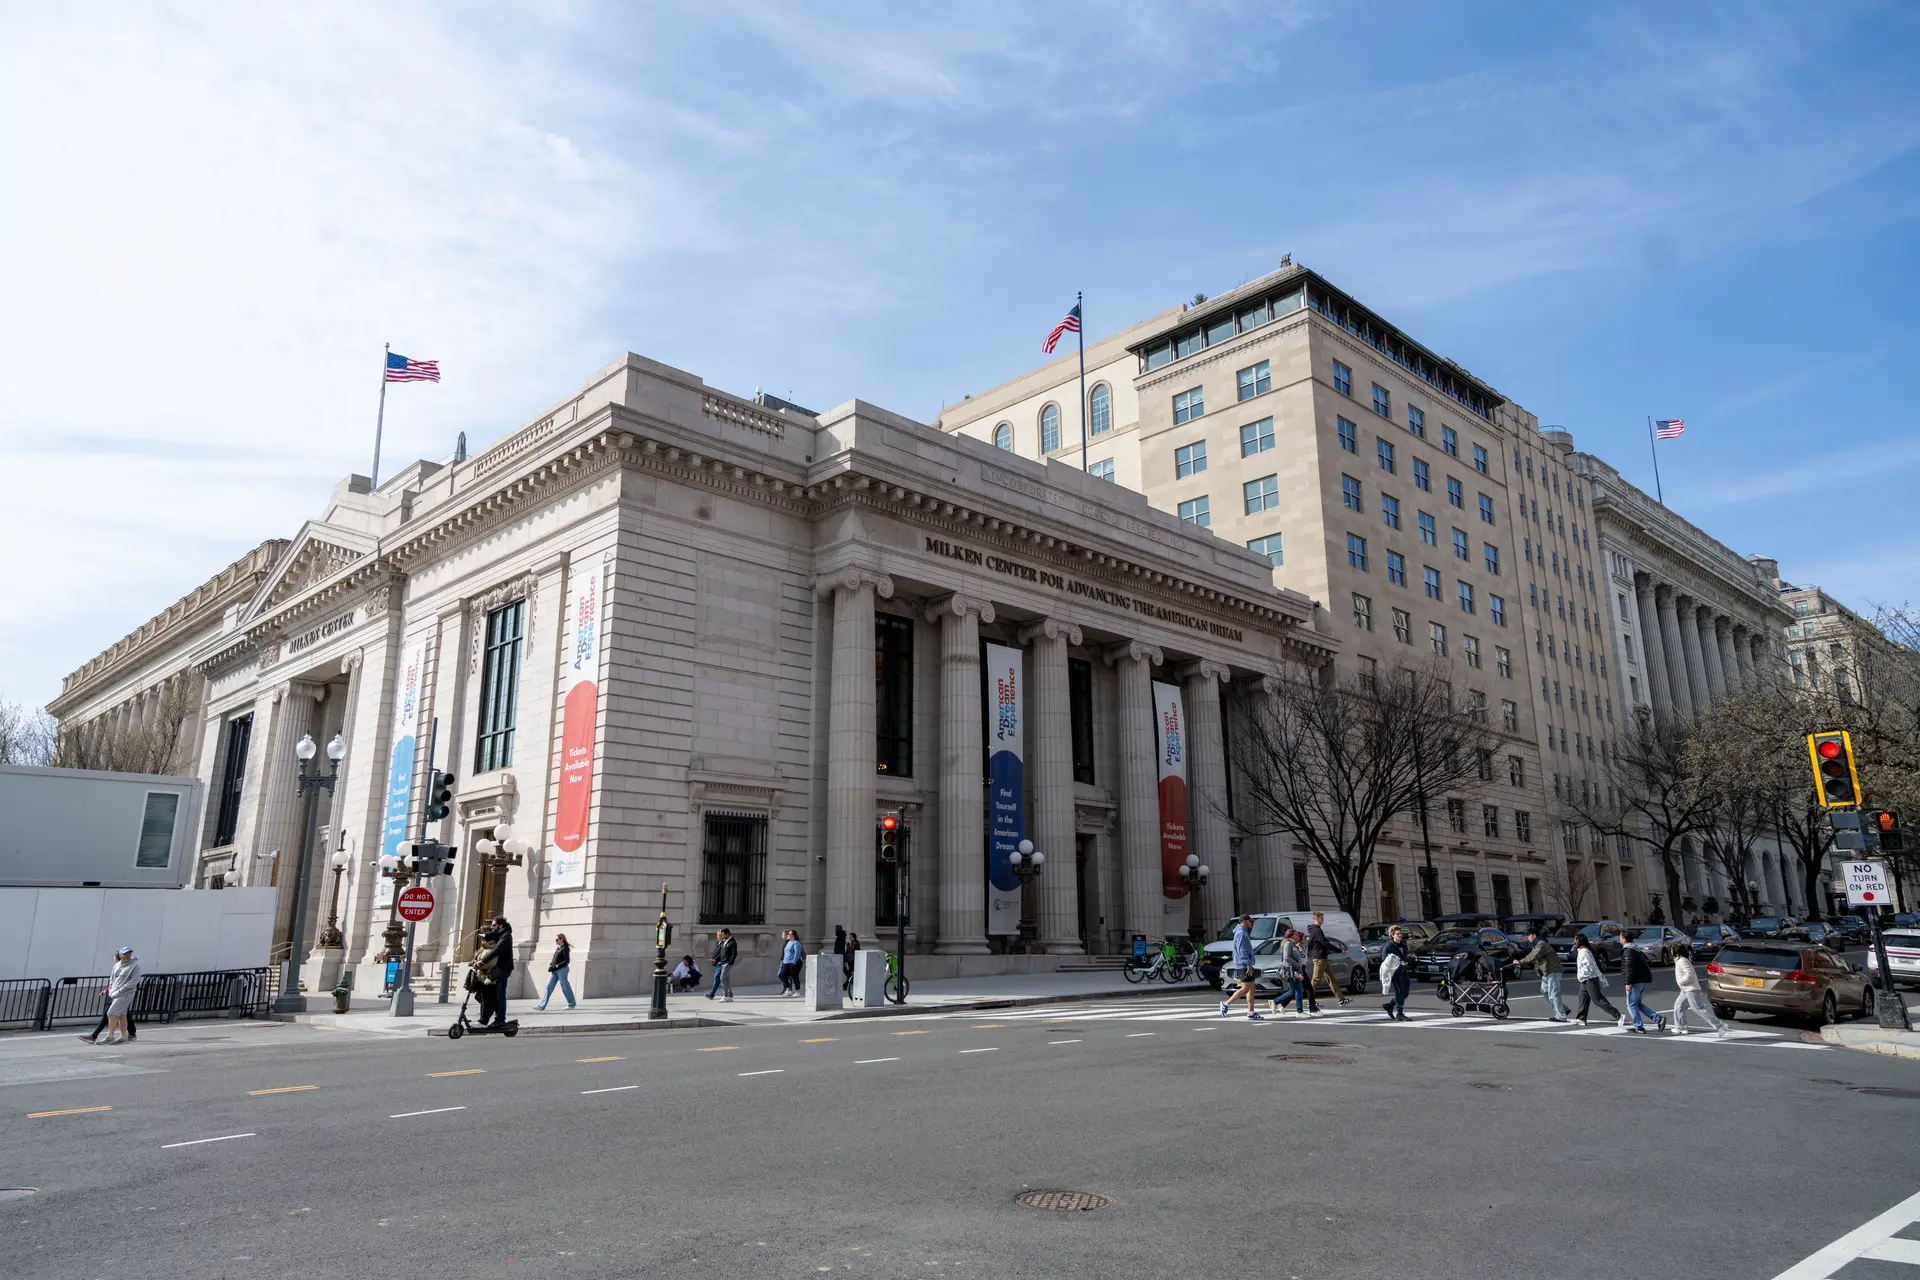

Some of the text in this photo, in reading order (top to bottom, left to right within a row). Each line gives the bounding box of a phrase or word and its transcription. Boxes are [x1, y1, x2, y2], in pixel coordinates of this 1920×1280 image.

[926, 536, 1243, 643] MILKEN CENTER FOR ADVANCING THE AMERICAN DREAM
[585, 575, 596, 660] Experience
[581, 599, 590, 653] Dream
[574, 596, 585, 670] American
[1002, 684, 1010, 728] Dream
[1008, 667, 1017, 737] Experience
[997, 678, 1005, 741] American
[1171, 702, 1182, 763] Experience
[1164, 711, 1173, 766] American
[569, 746, 587, 757] Tickets
[564, 758, 590, 771] Available
[569, 774, 583, 784] Now
[1000, 788, 1012, 797] Find
[995, 801, 1017, 811] Yourself
[997, 814, 1013, 824] in the
[1166, 822, 1184, 831] Tickets
[993, 827, 1019, 838] American
[995, 841, 1015, 850] Dream
[1167, 842, 1182, 850] Now
[1854, 865, 1872, 873] NO
[1866, 883, 1885, 891] RED
